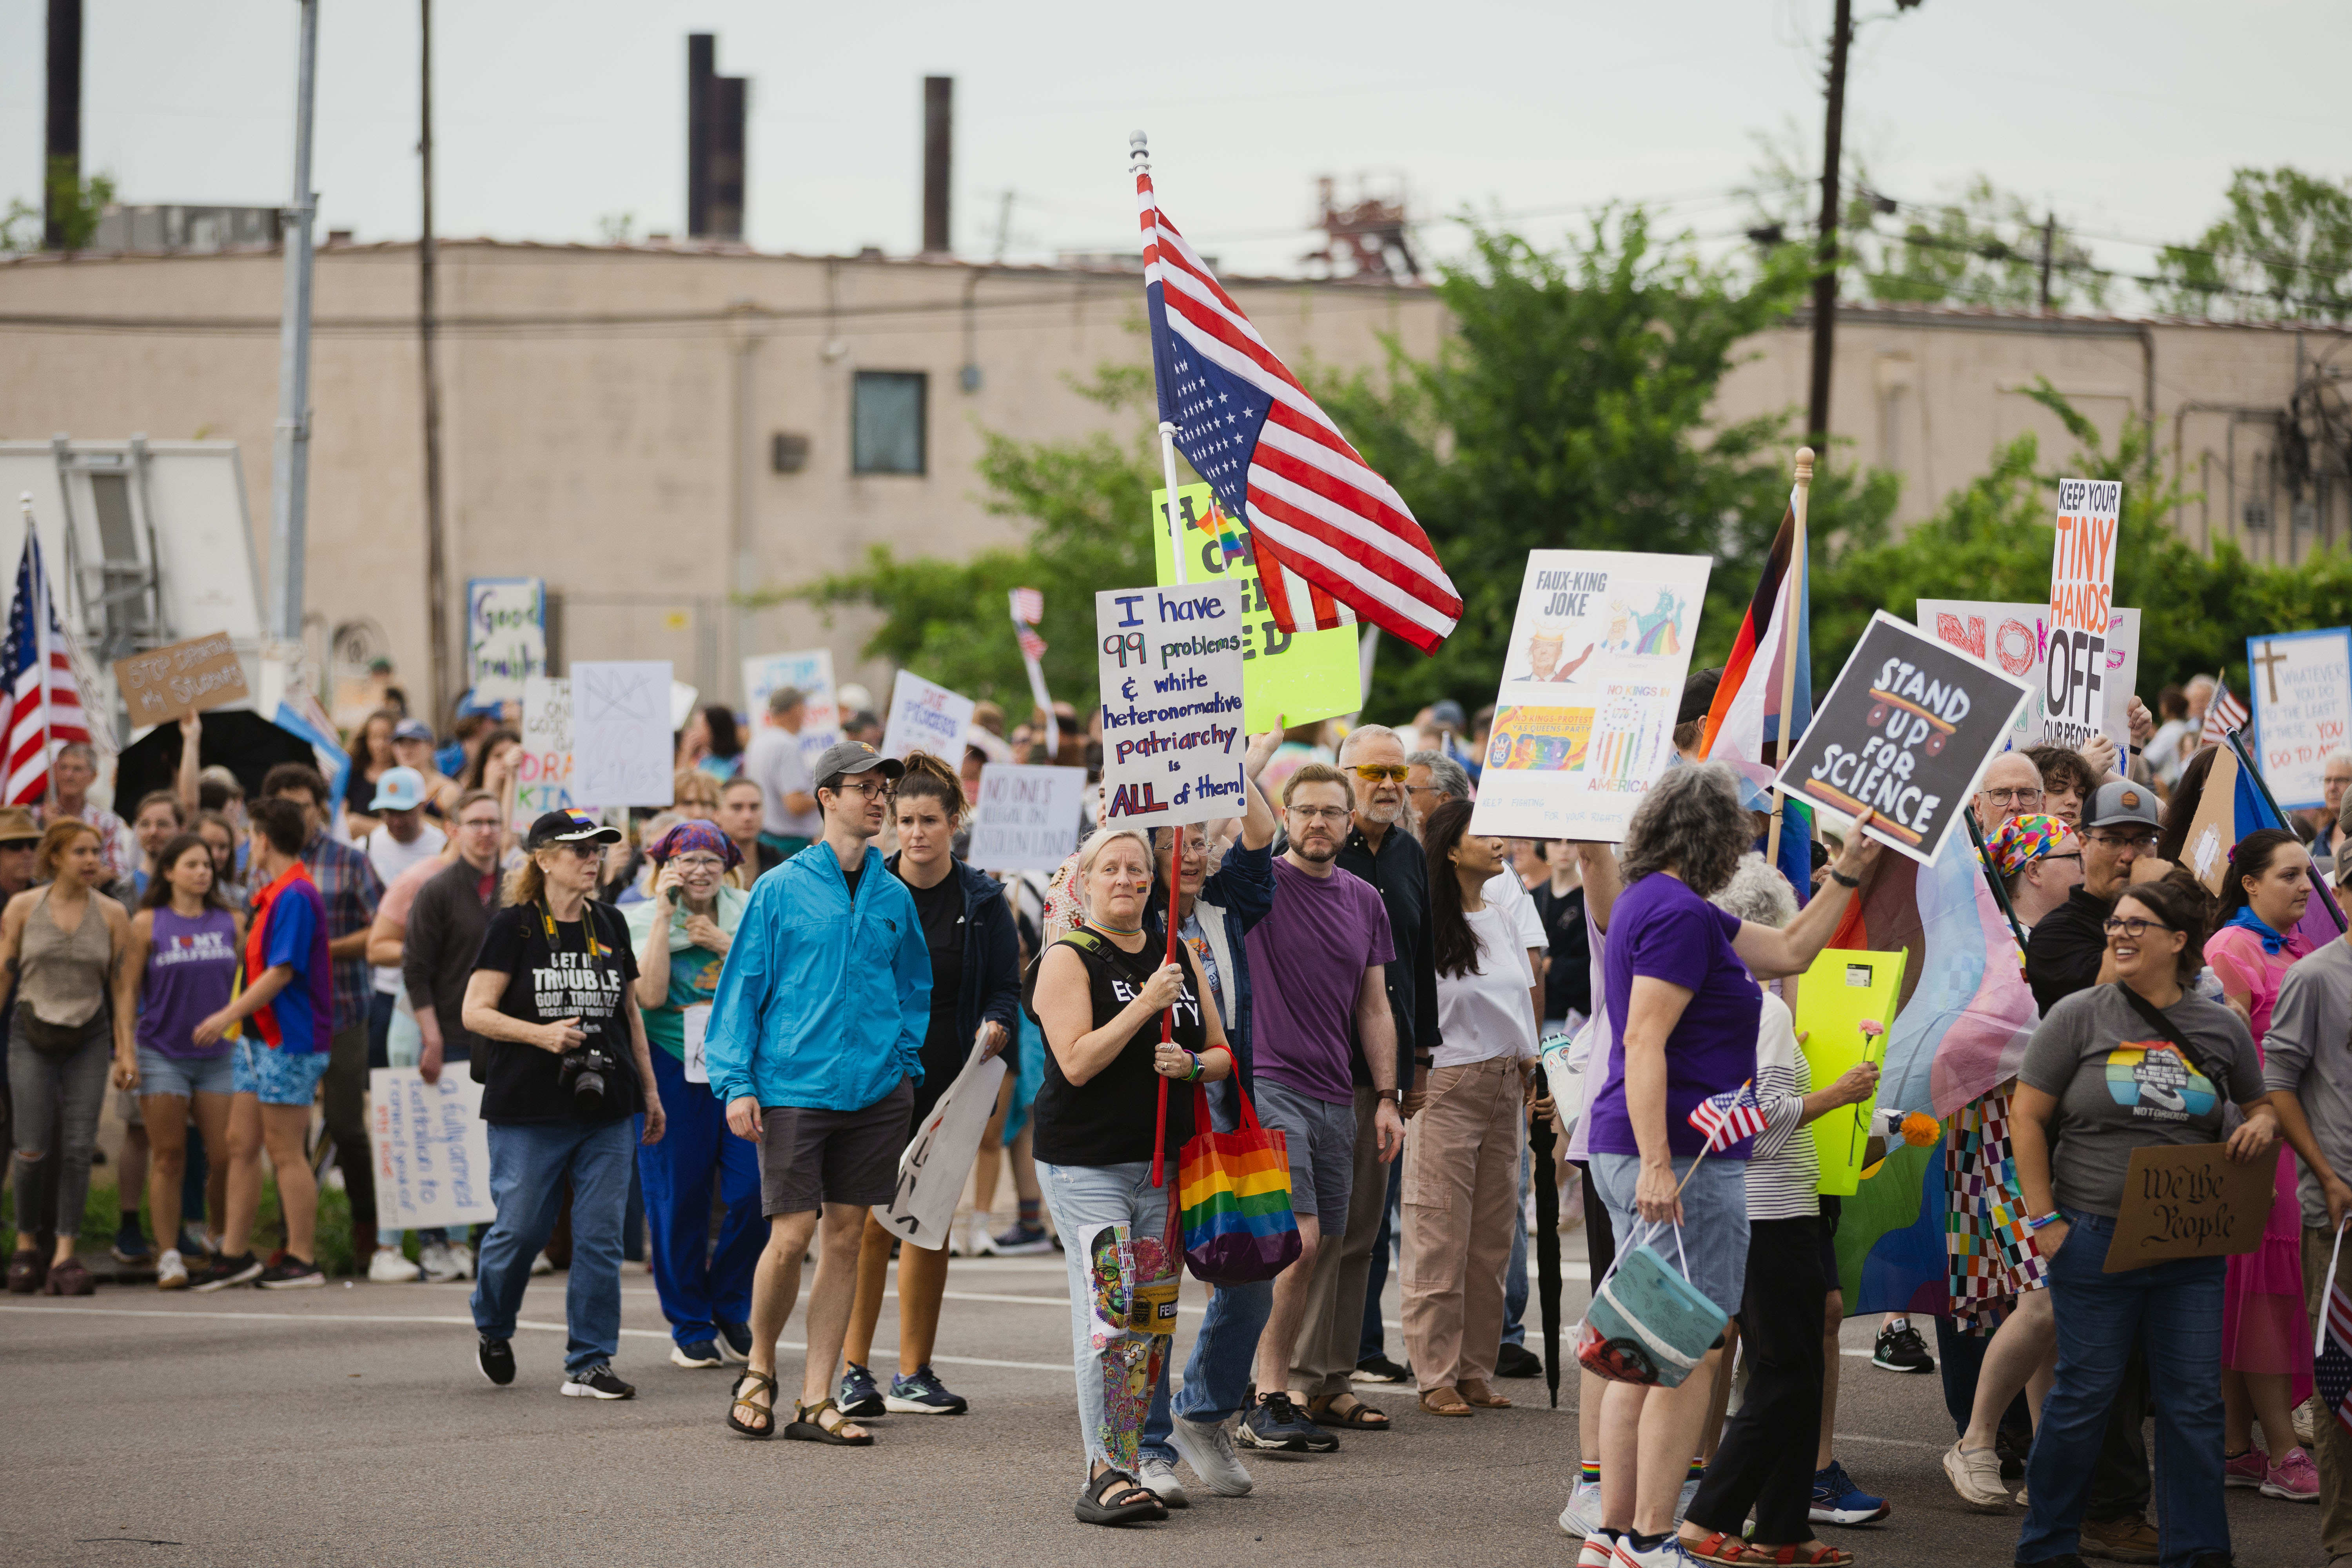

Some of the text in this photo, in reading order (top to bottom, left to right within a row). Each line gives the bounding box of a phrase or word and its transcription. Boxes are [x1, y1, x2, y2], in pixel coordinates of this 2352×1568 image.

[2059, 481, 2117, 513] KEEP YOUR
[2058, 516, 2115, 583] TINY
[1536, 570, 1608, 593] FAUX-KING
[1115, 595, 1143, 627] I
[1158, 593, 1225, 622] have
[1544, 592, 1590, 617] JOKE
[2050, 583, 2110, 634] HANDS
[1103, 632, 1240, 669] 99 problems
[128, 656, 171, 688] STOP
[1121, 668, 1207, 701] & white
[2046, 629, 2105, 724] OFF
[1607, 685, 1670, 697] NO KINGS IN
[1874, 657, 1970, 724] STAND
[2294, 683, 2335, 702] YOU DO
[1103, 691, 1242, 729] heteronormative
[1612, 708, 1630, 719] 1776
[2279, 704, 2300, 719] THE
[2305, 698, 2340, 719] LEAST
[1116, 724, 1237, 764] patriarchy
[1886, 709, 1930, 749] UP
[2043, 720, 2062, 746] OUR
[2316, 720, 2343, 741] YOU
[521, 752, 574, 782] DRA
[1168, 760, 1180, 771] is
[1862, 736, 1916, 781] FOR
[2270, 750, 2291, 770] DO
[2294, 744, 2312, 764] TO
[1108, 762, 1245, 817] ALL of them!
[1588, 778, 1649, 793] AMERICA
[1811, 743, 1941, 833] SCIENCE
[1482, 798, 1544, 807] KEEP FIGHTING
[1544, 811, 1623, 823] FOR YOUR RIGHTS
[532, 967, 621, 991] TROUBLE
[2133, 1107, 2190, 1121] NOTORIOUS
[418, 1179, 441, 1204] to
[2143, 1167, 2182, 1201] We
[1114, 1226, 1128, 1240] NOT
[2141, 1203, 2234, 1248] People
